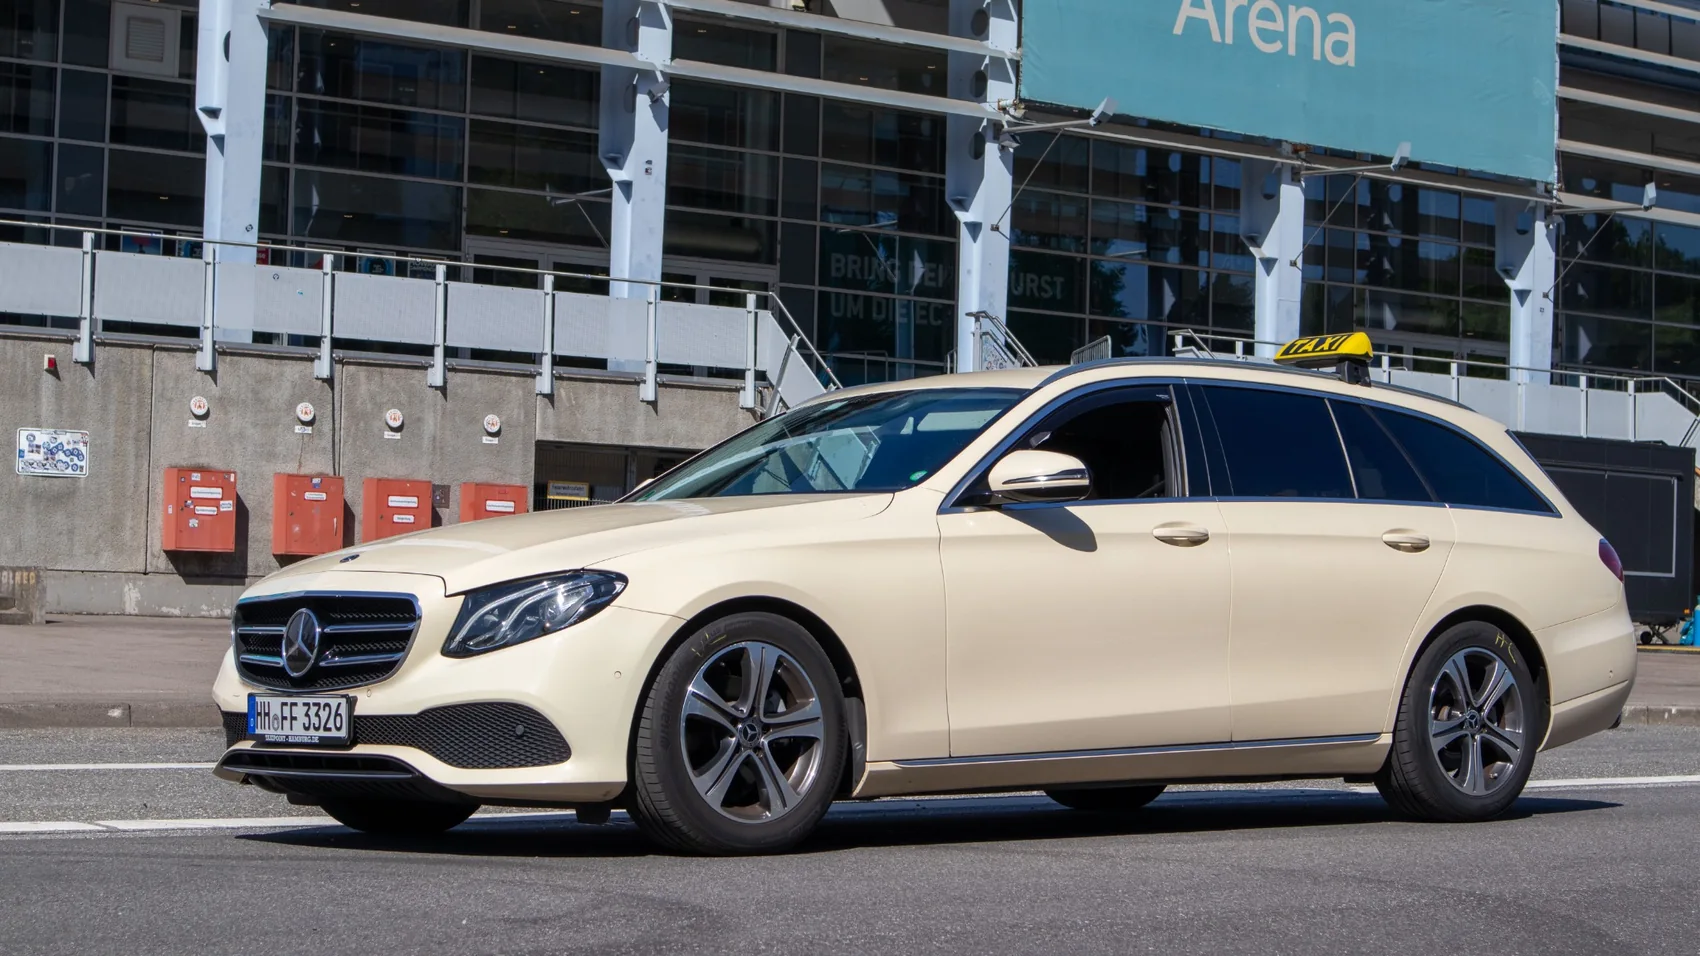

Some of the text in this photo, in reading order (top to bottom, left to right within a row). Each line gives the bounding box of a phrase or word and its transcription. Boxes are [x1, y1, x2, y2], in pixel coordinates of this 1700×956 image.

[1172, 0, 1356, 67] Arena
[830, 253, 901, 283] BRING
[1010, 271, 1065, 300] URST
[830, 293, 864, 320] UM
[1288, 335, 1348, 354] TAXI
[256, 701, 343, 732] HH FF 3326
